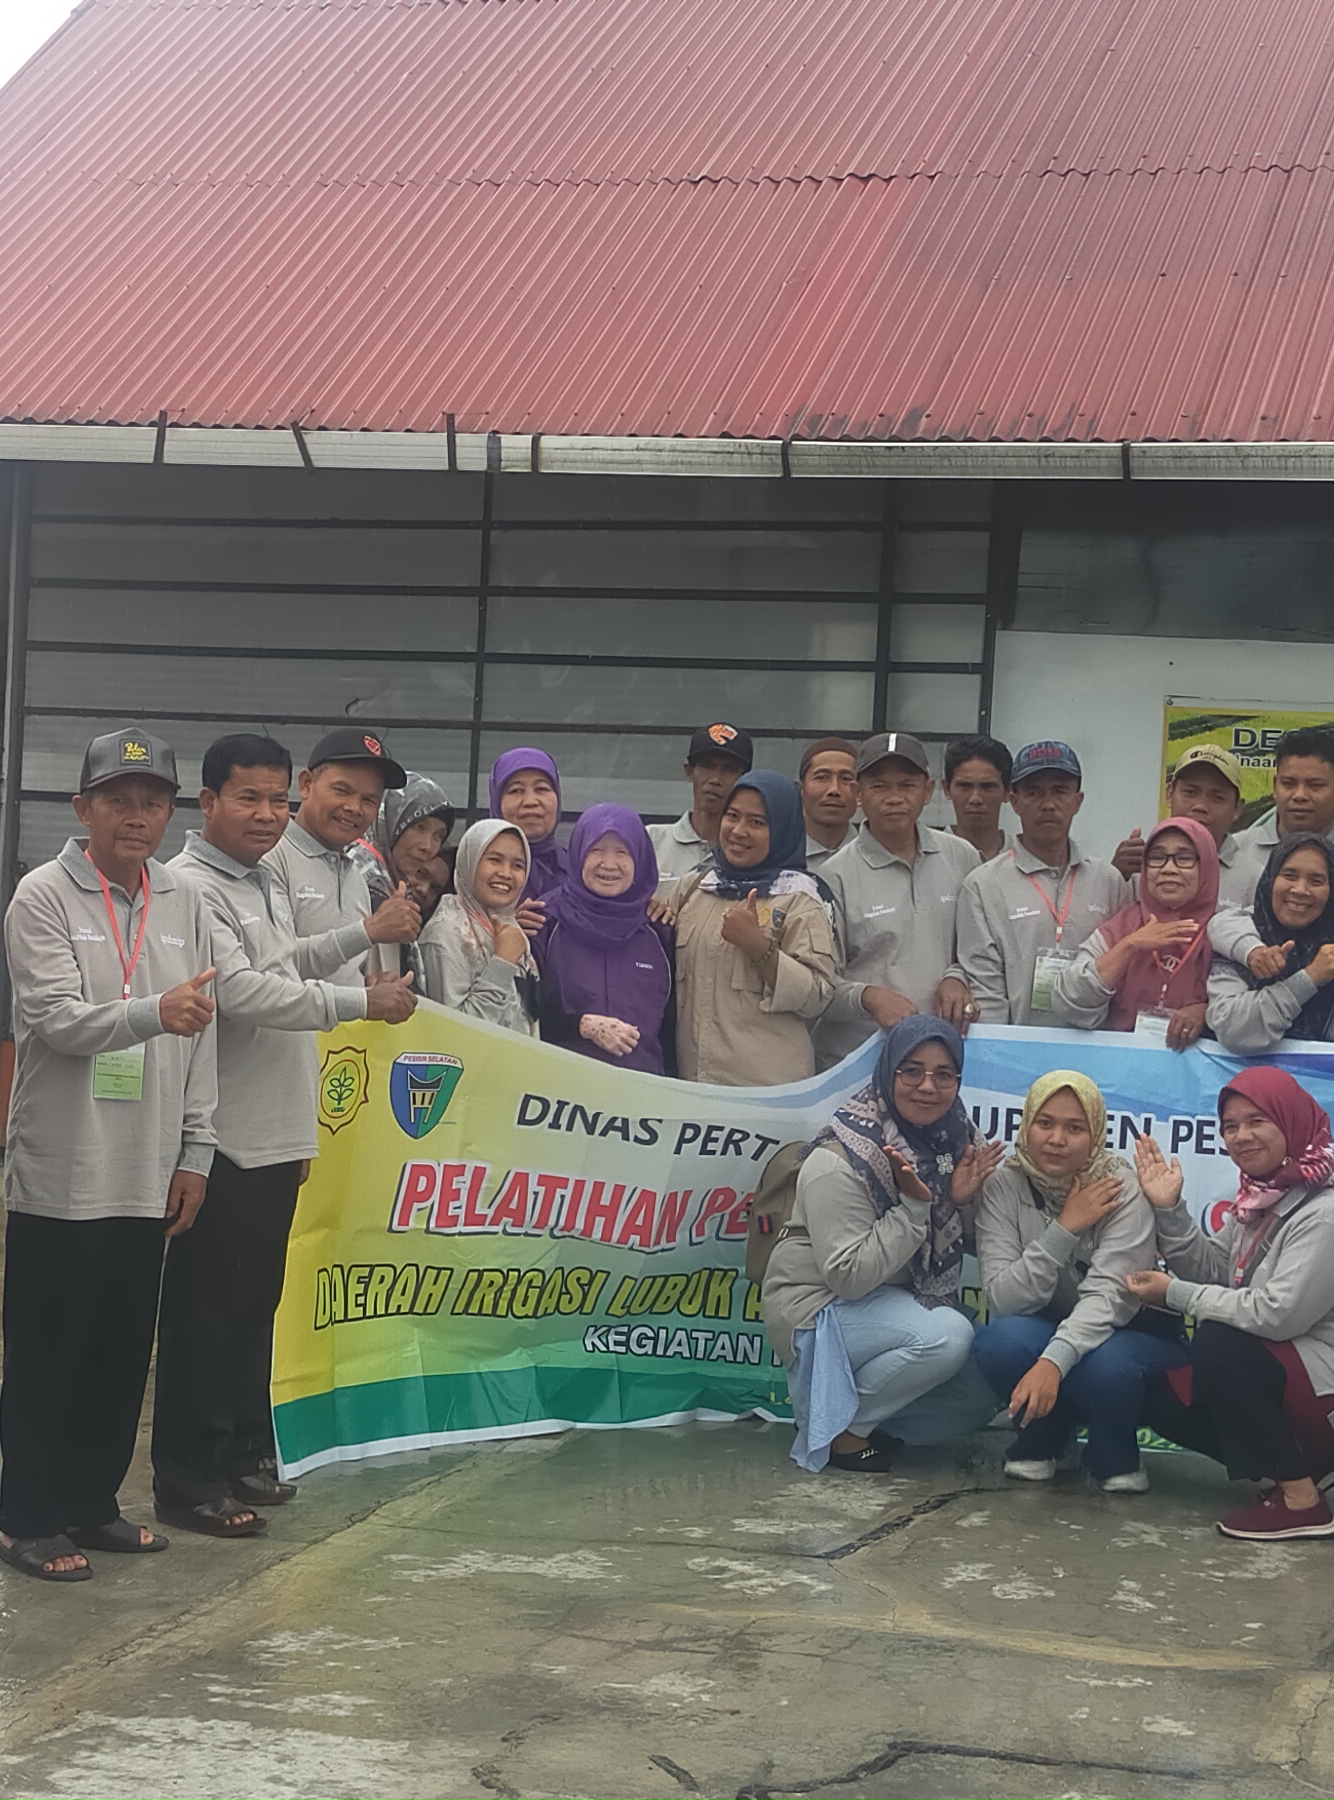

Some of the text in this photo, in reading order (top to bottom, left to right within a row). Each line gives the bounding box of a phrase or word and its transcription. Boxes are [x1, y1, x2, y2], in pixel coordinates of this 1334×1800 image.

[428, 1056, 458, 1065] SELATAN
[517, 1094, 663, 1147] DINAS
[389, 1160, 694, 1254] PELATIHAN
[314, 1264, 451, 1330] DAERAH
[451, 1267, 611, 1318] IRIGASI
[613, 1266, 739, 1321] LUBUK
[583, 1324, 763, 1366] KEGIATAN
